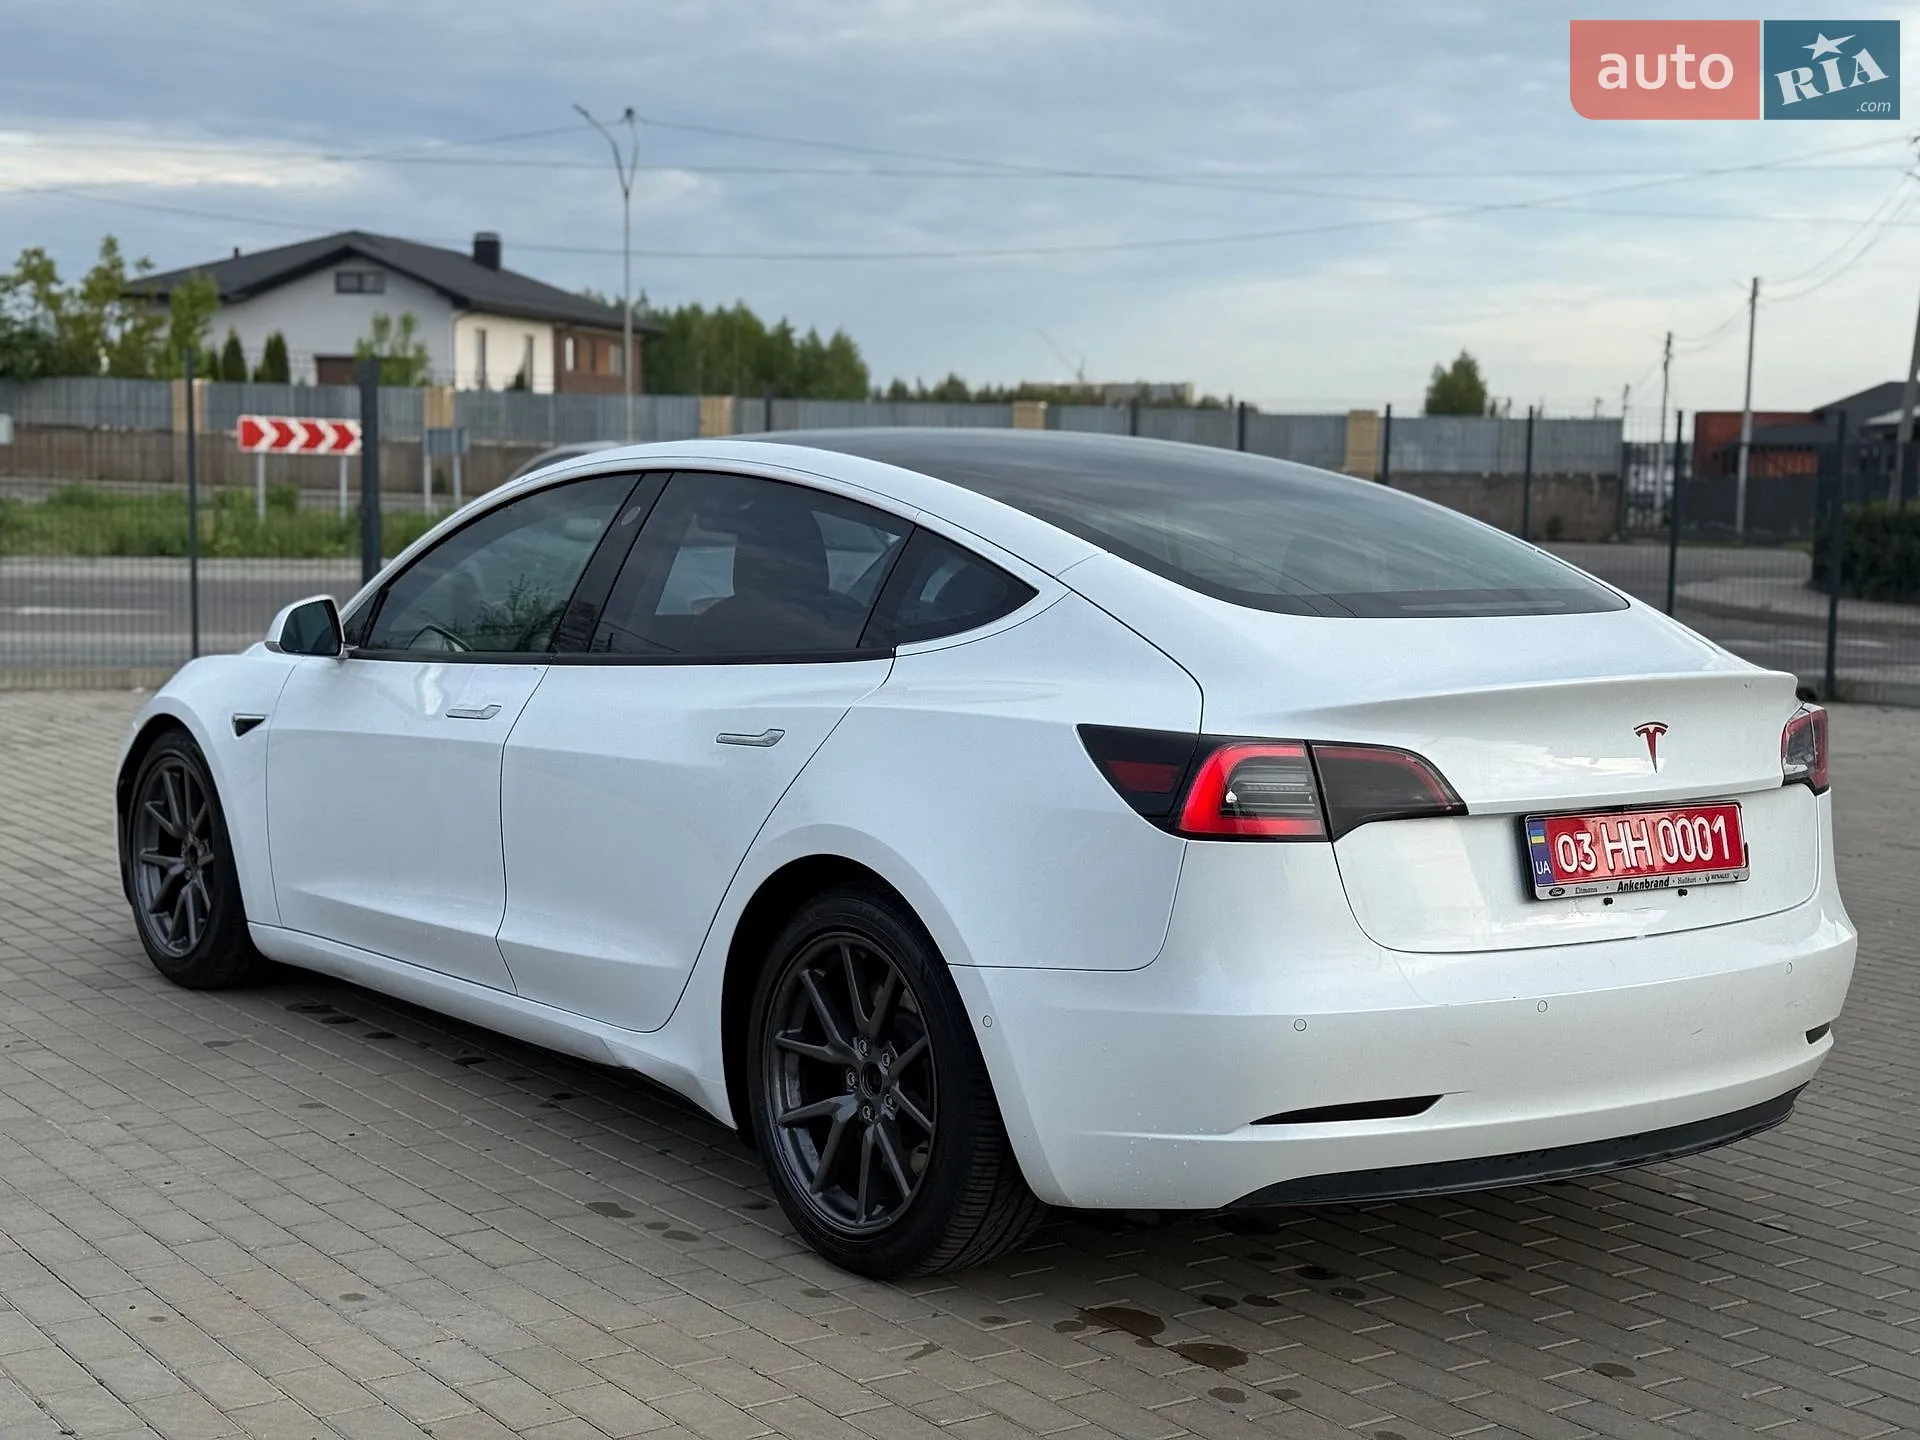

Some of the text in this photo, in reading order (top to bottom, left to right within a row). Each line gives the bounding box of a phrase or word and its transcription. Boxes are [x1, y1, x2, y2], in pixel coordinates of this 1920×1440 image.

[1557, 815, 1730, 873] 03 HH 0001
[1535, 860, 1552, 875] UA
[1617, 876, 1669, 893] Ankenbrand
